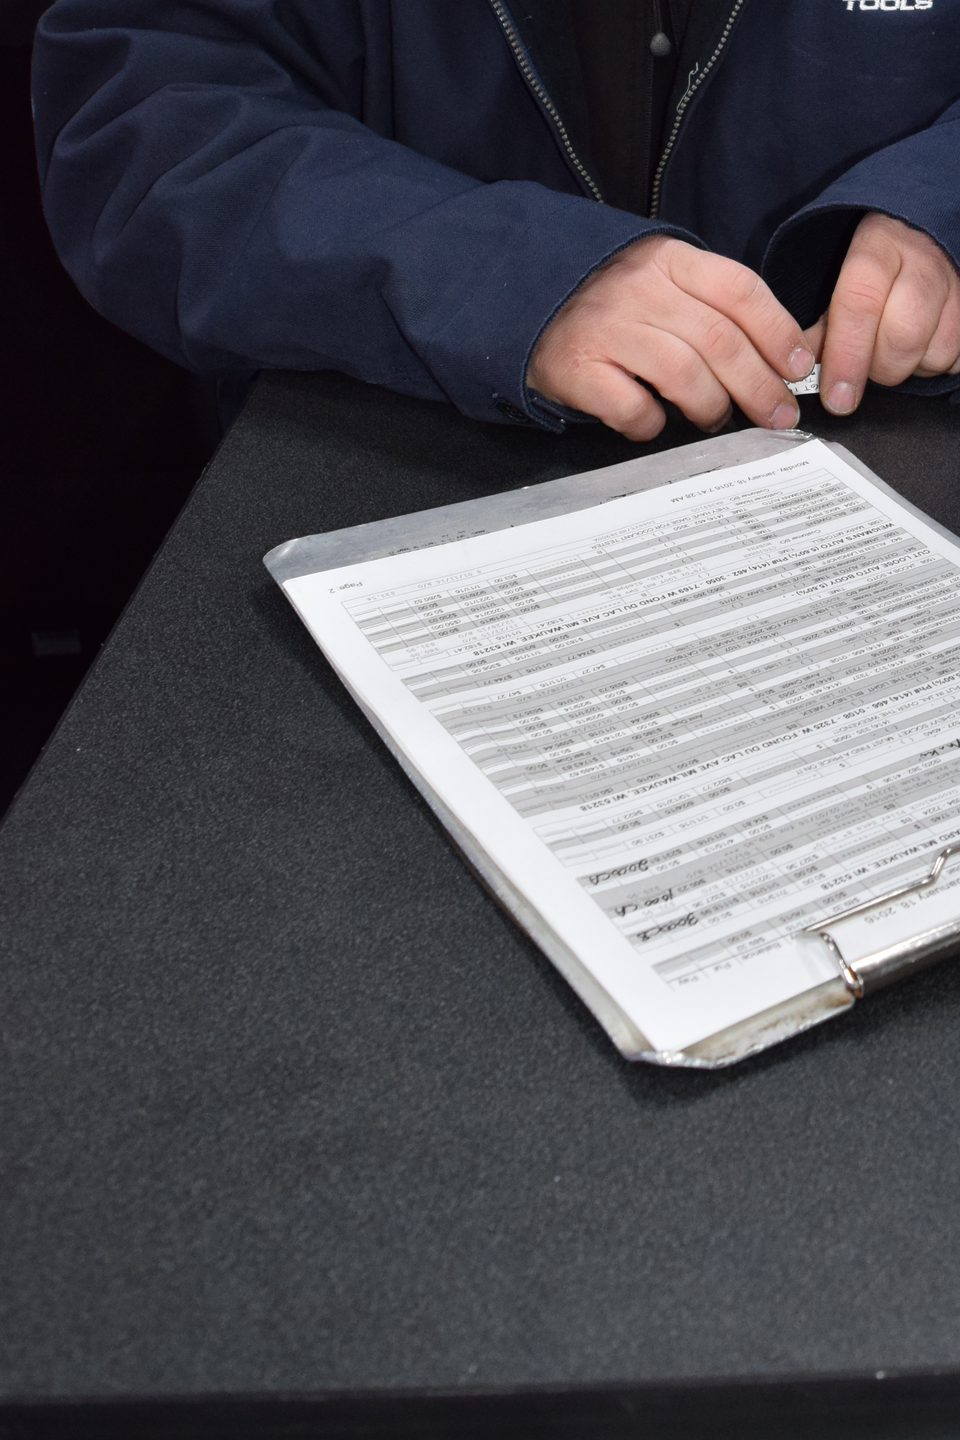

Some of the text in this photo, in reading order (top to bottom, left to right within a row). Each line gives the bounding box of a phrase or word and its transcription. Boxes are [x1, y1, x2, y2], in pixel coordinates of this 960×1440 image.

[777, 460, 809, 472] Monday,
[747, 470, 776, 481] January
[714, 481, 735, 490] 2016
[670, 495, 684, 503] AM
[845, 522, 894, 541] WEIGMAN'S
[820, 538, 844, 549] AUTO
[912, 549, 931, 558] CUT
[747, 561, 771, 571] (414)
[881, 555, 912, 568] LOOSE
[855, 565, 880, 576] AUTO
[829, 573, 855, 585] BODY
[338, 581, 363, 590] Page:
[638, 594, 666, 606] FOND
[601, 607, 623, 617] LAC
[623, 602, 638, 611] DU
[580, 614, 600, 623] AVE
[516, 621, 580, 642] MILWAUKEE,
[502, 639, 517, 647] WI
[472, 644, 501, 656] 53218
[888, 690, 913, 702] (414)
[761, 732, 798, 748] FOUND
[744, 745, 761, 755] DU
[721, 751, 744, 763] LAC
[698, 759, 719, 771] AVE
[627, 768, 697, 795] MILWAUKEE,
[611, 793, 628, 801] WI
[579, 798, 611, 811] 53218
[872, 839, 937, 868] MILWAUKEE,
[852, 866, 869, 876] WI
[820, 873, 852, 890] 53218
[864, 906, 896, 923] 2016
